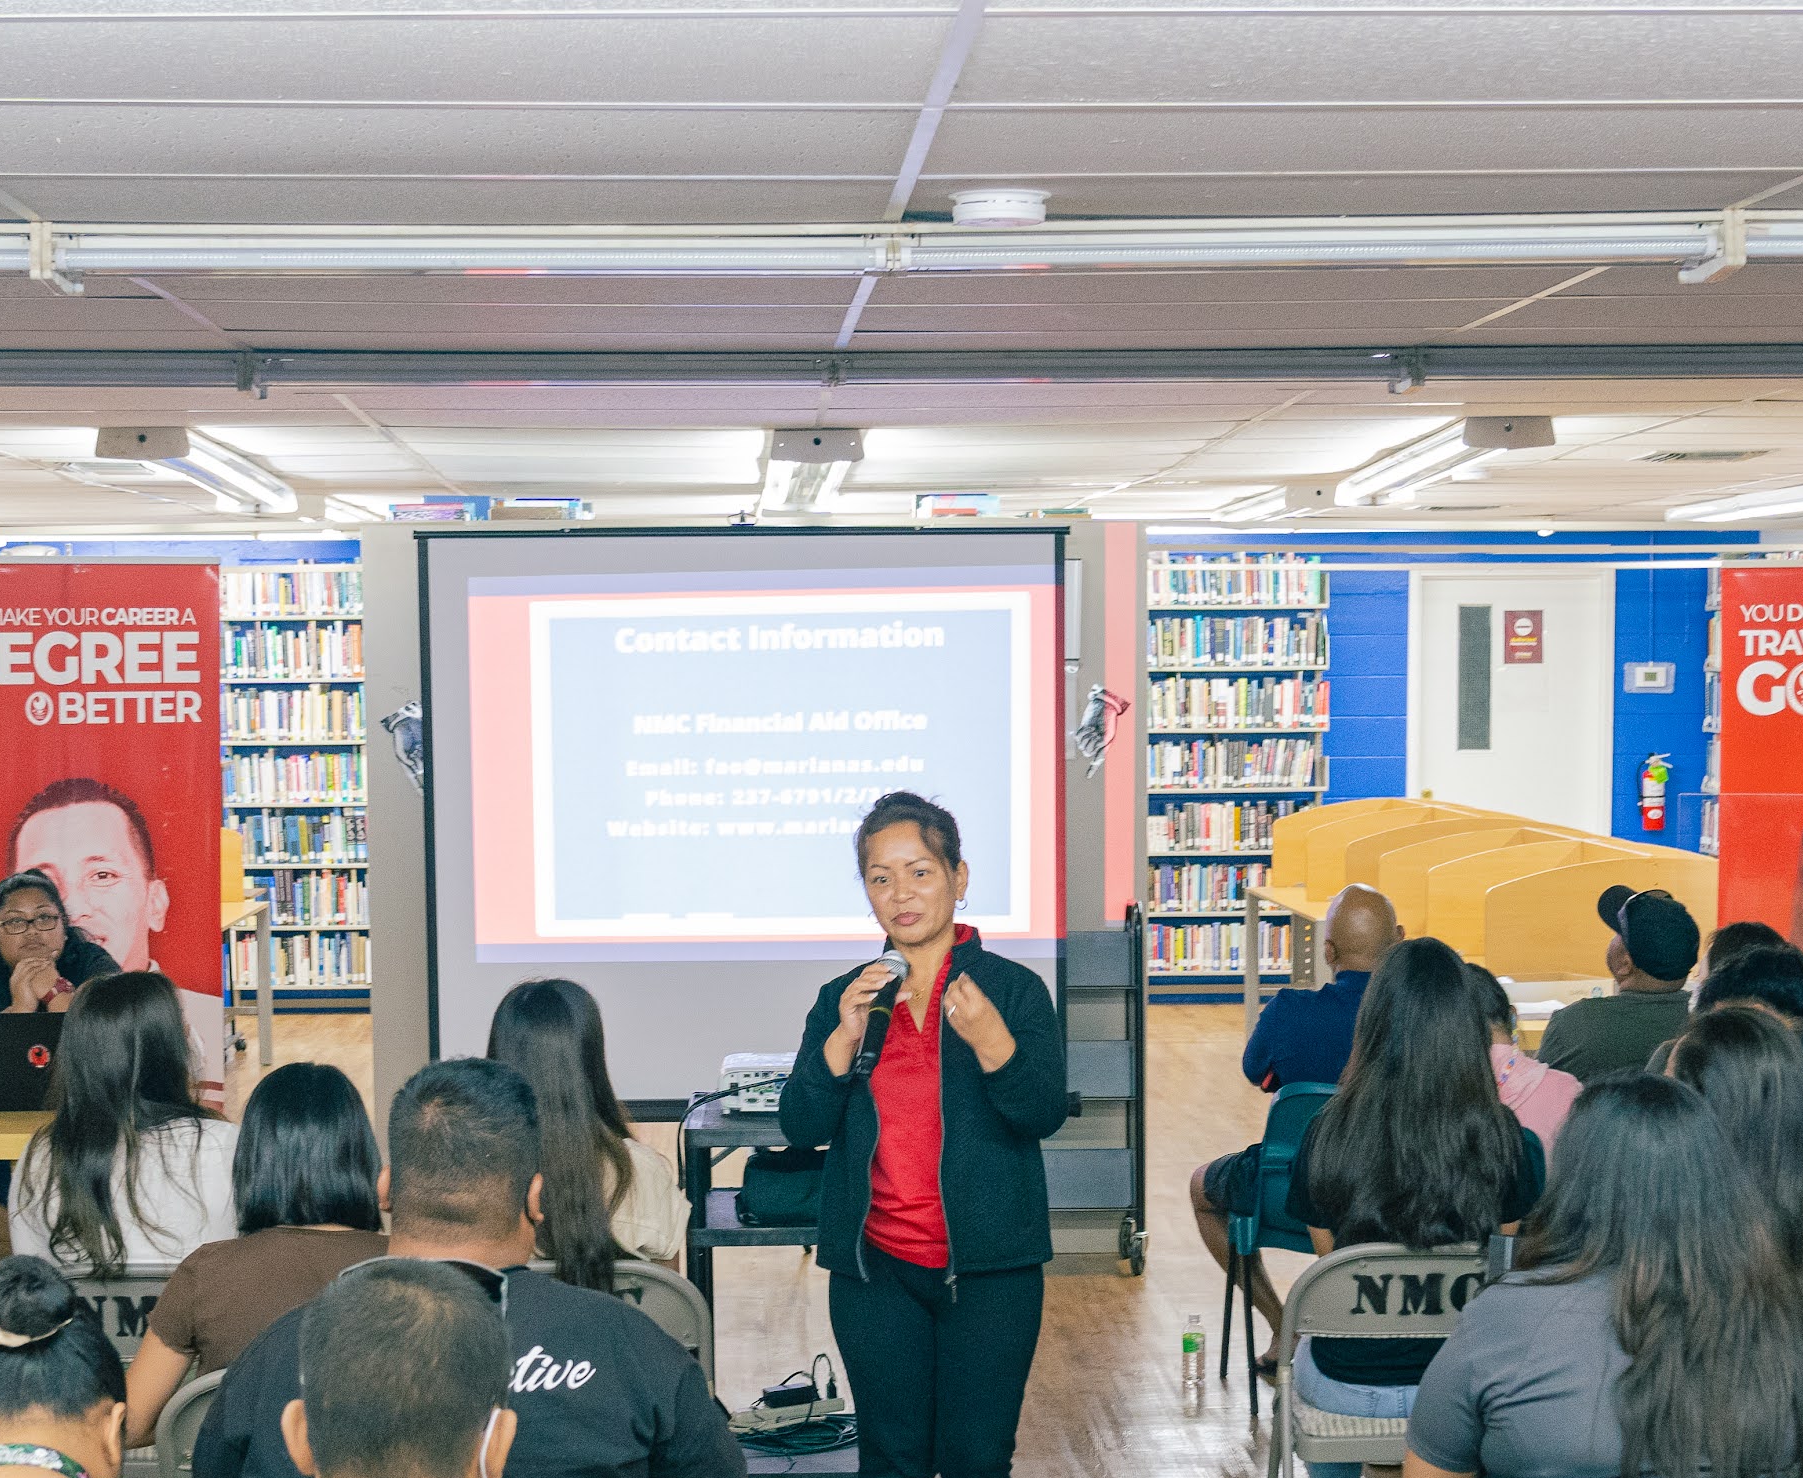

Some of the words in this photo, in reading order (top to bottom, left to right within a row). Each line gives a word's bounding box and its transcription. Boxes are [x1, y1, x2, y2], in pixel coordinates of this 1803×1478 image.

[43, 608, 99, 626] YOUR
[100, 607, 180, 626] CAREER
[180, 608, 196, 625] A
[1739, 603, 1784, 623] YOU
[614, 627, 742, 653] Contact
[749, 620, 945, 651] Information
[58, 690, 202, 725] BETTER
[633, 714, 691, 735] NMC
[696, 711, 803, 734] Financial
[808, 709, 848, 732] Aid
[853, 709, 928, 731] Office
[625, 758, 698, 777] Email:
[645, 788, 725, 807] Phone:
[606, 818, 710, 837] Website:
[508, 1345, 597, 1393] tive
